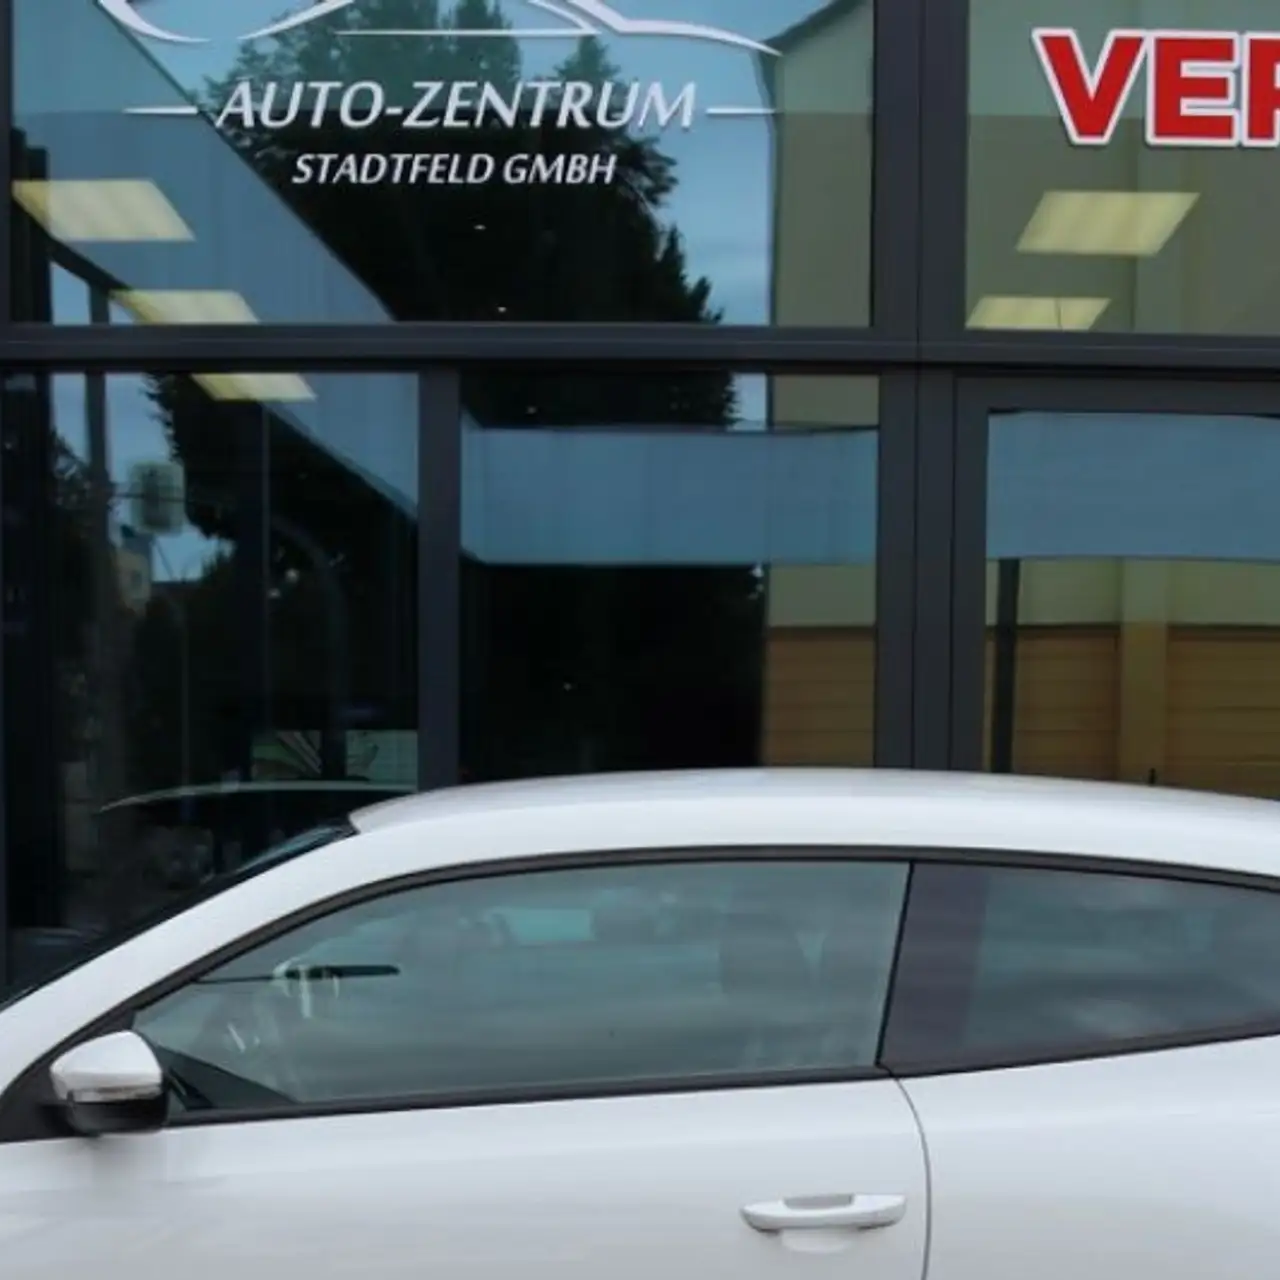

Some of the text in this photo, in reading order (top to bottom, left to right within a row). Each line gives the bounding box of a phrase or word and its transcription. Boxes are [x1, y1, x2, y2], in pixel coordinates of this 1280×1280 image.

[215, 80, 697, 130] AUTO-ZENTRUM
[292, 153, 618, 186] STADTFELD GMBH
